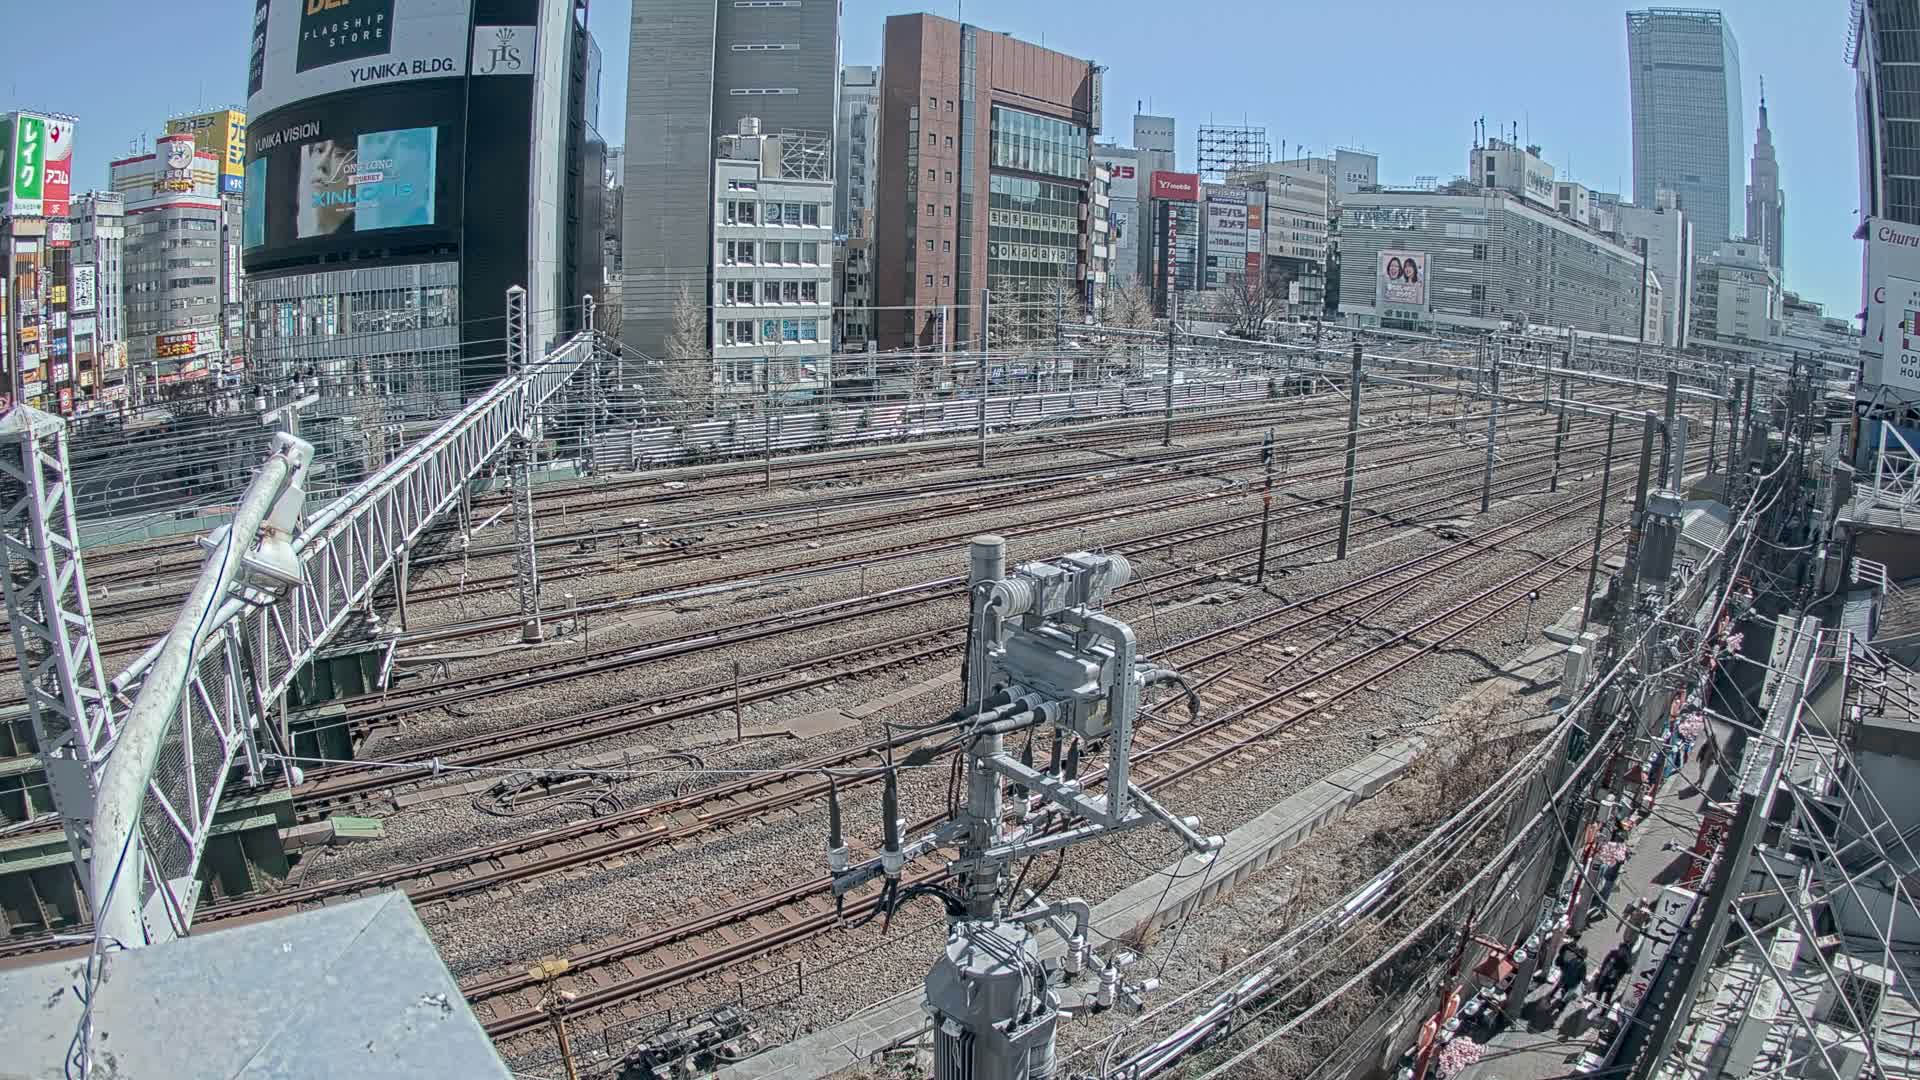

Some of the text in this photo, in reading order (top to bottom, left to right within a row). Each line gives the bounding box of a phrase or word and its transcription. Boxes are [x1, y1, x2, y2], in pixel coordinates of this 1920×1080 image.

[304, 14, 384, 40] FLAGSHIP
[329, 28, 383, 47] STORE
[350, 57, 457, 83] YUNIKA BLDG.
[255, 120, 321, 153] YUNIKA VISION
[21, 121, 38, 189] レイク
[45, 168, 69, 185] アコム
[1000, 244, 1066, 262] okadaya
